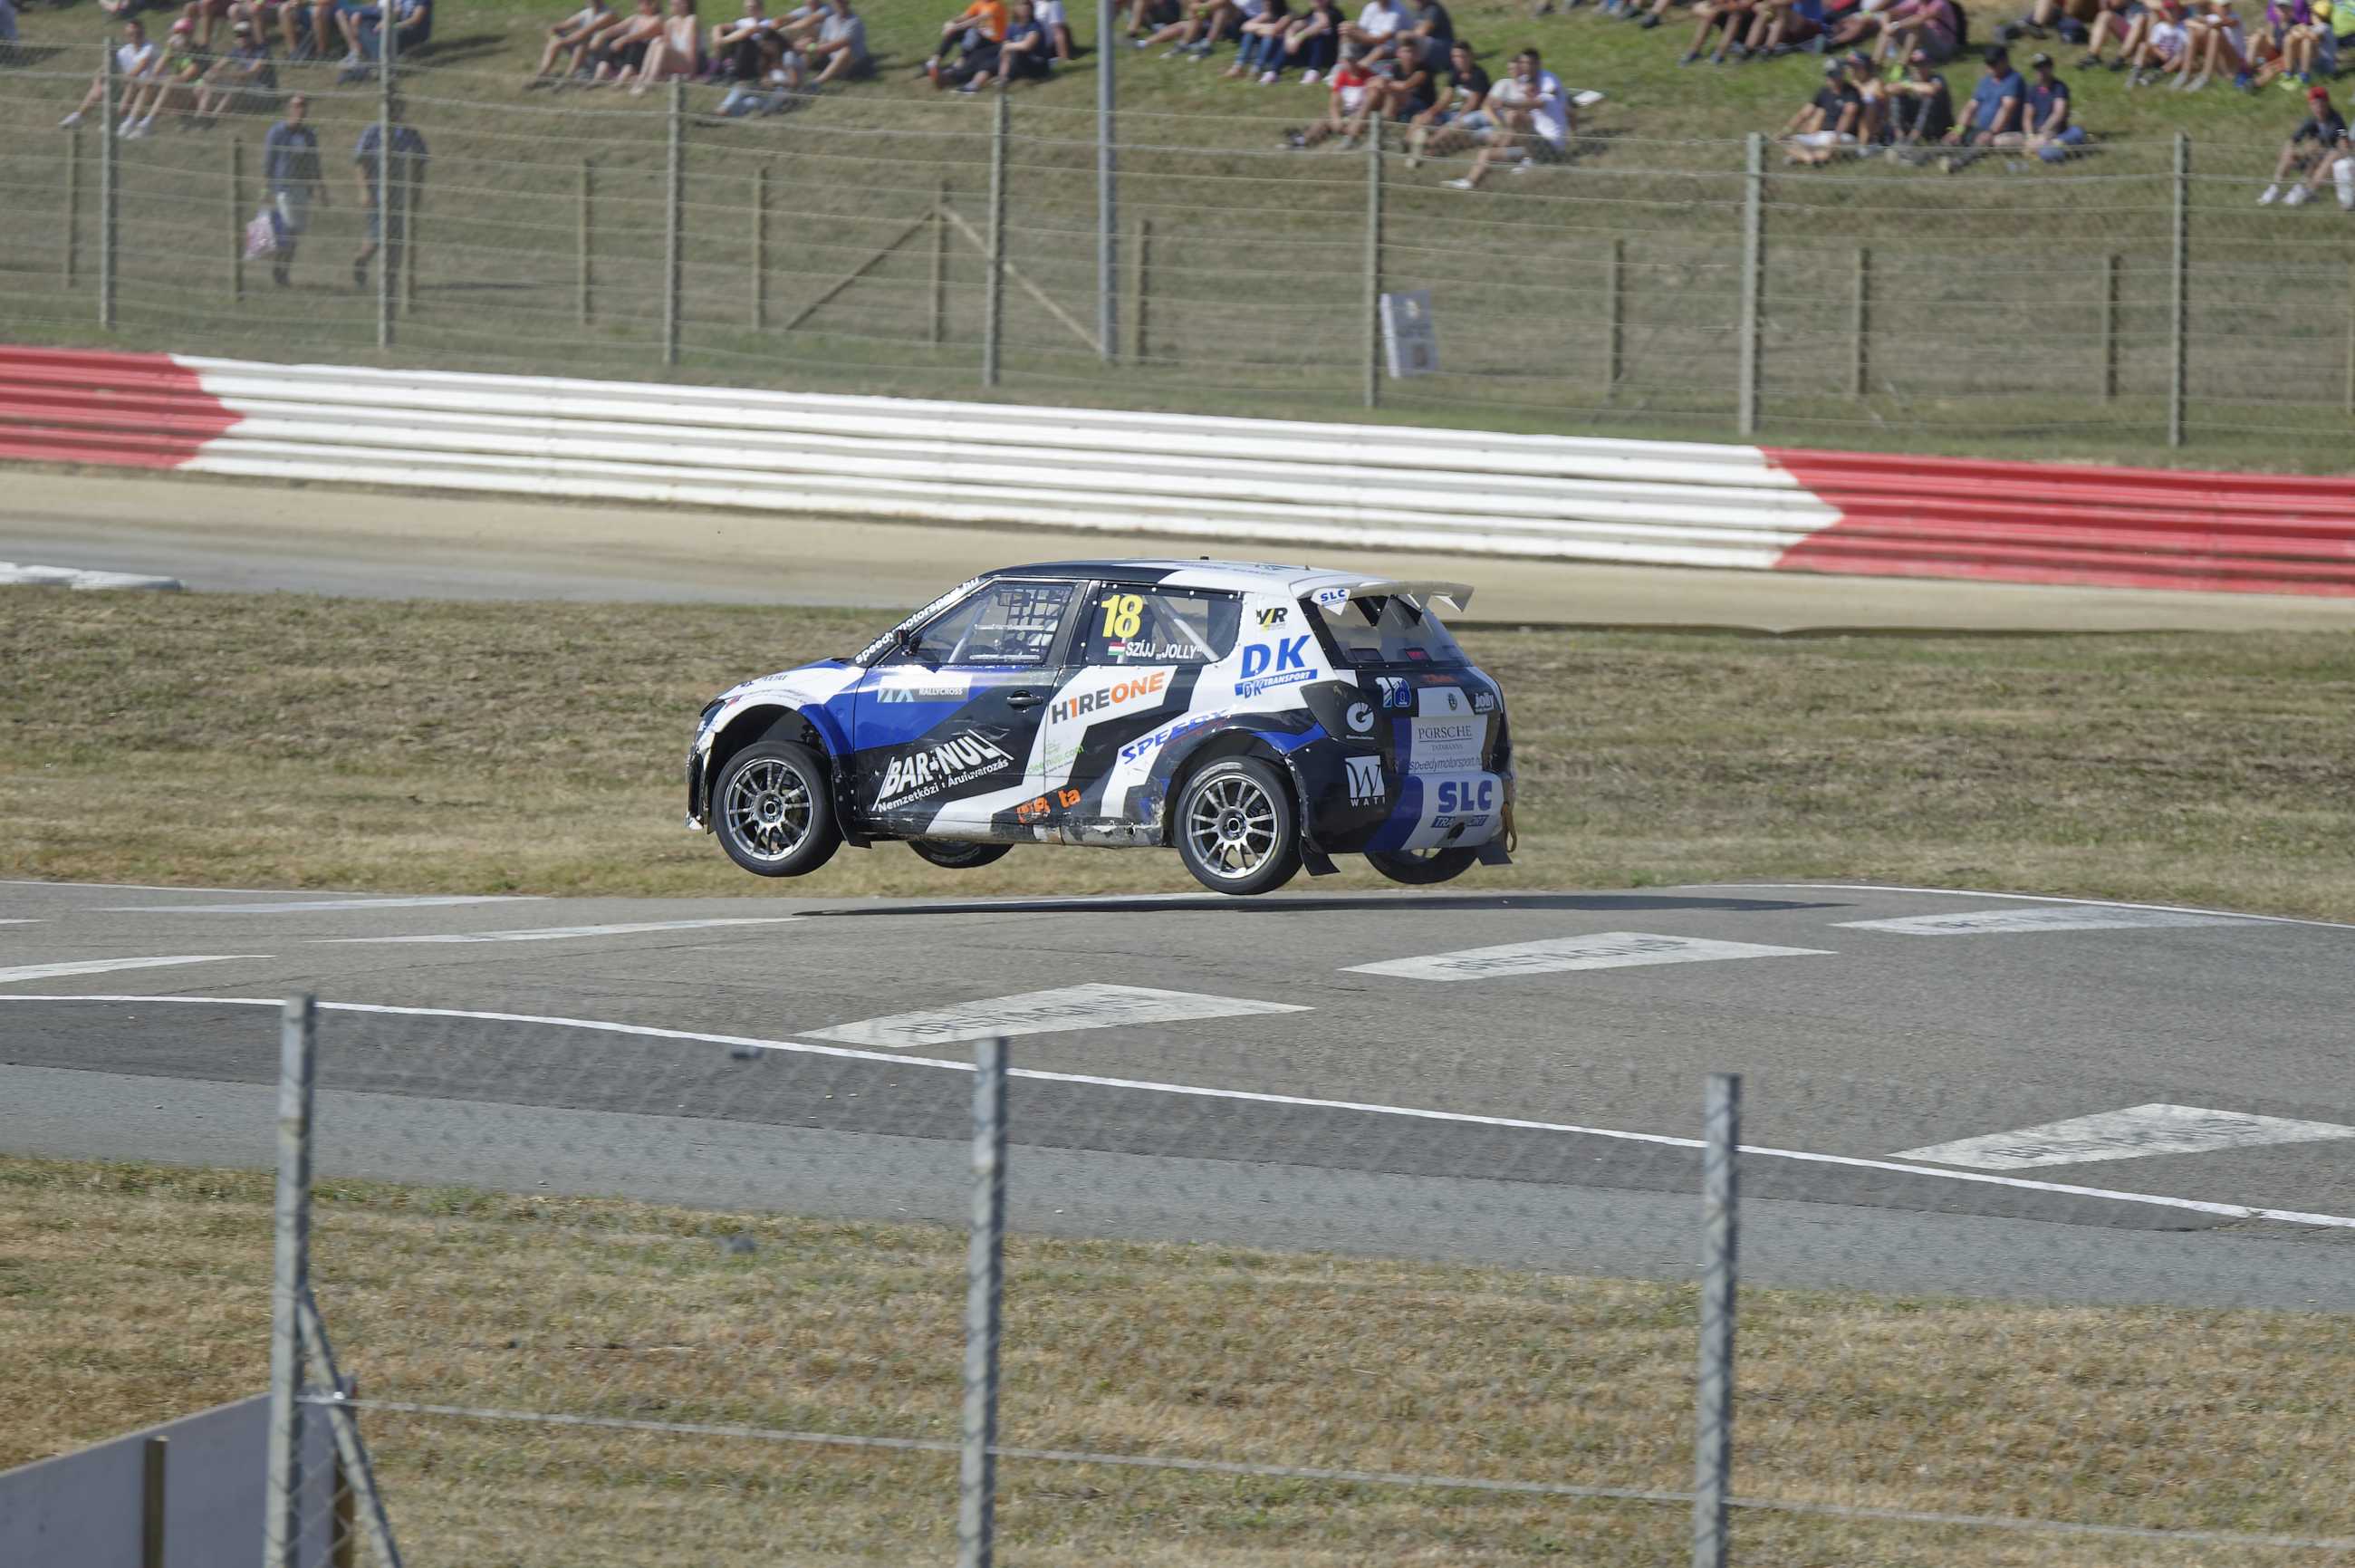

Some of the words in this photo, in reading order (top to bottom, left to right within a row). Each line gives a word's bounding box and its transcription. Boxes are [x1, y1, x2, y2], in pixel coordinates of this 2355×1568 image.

[1321, 589, 1345, 601] SLC
[1101, 593, 1143, 638] 18
[1240, 634, 1312, 679] DK
[1263, 670, 1311, 687] TRANSPORT
[1418, 726, 1472, 740] PORSCHE
[1438, 780, 1493, 813] SLC
